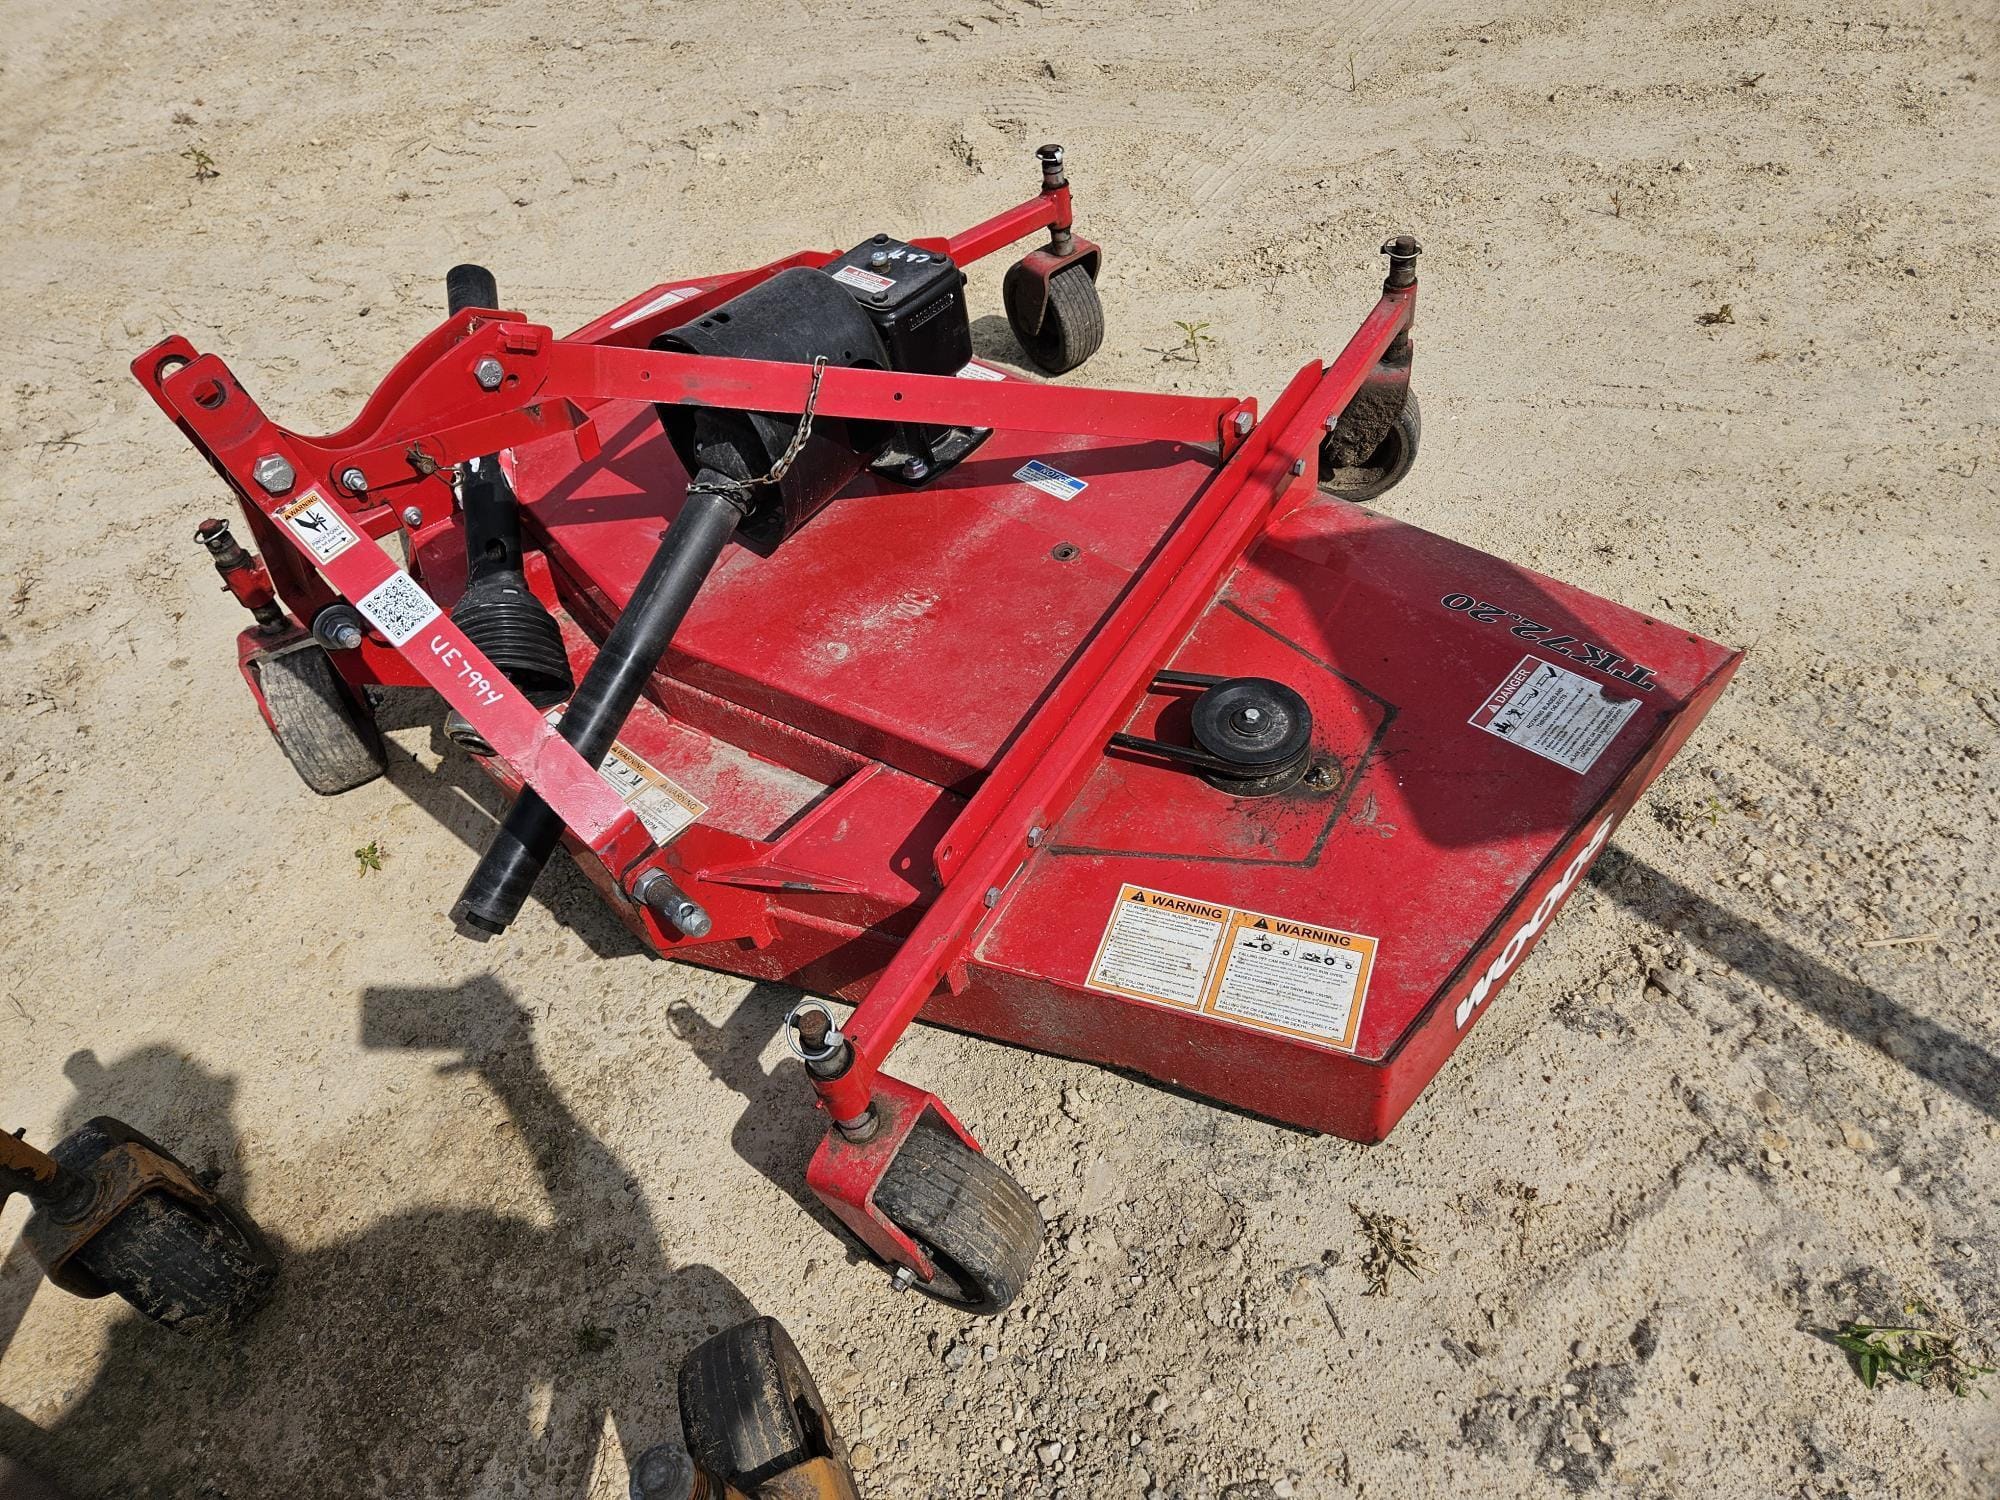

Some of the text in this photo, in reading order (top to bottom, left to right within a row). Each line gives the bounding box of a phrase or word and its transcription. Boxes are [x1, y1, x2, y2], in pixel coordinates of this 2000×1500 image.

[1040, 468, 1073, 484] NOTICE
[290, 494, 318, 519] WARNING
[1440, 593, 1658, 691] TK72.20
[430, 634, 504, 706] UE7994
[1495, 668, 1530, 704] DANGER
[616, 746, 646, 772] WARNING
[664, 785, 698, 810] WARNING
[1151, 895, 1223, 920] WARNING
[1456, 813, 1614, 1030] WOODS
[1276, 922, 1351, 947] WARNING
